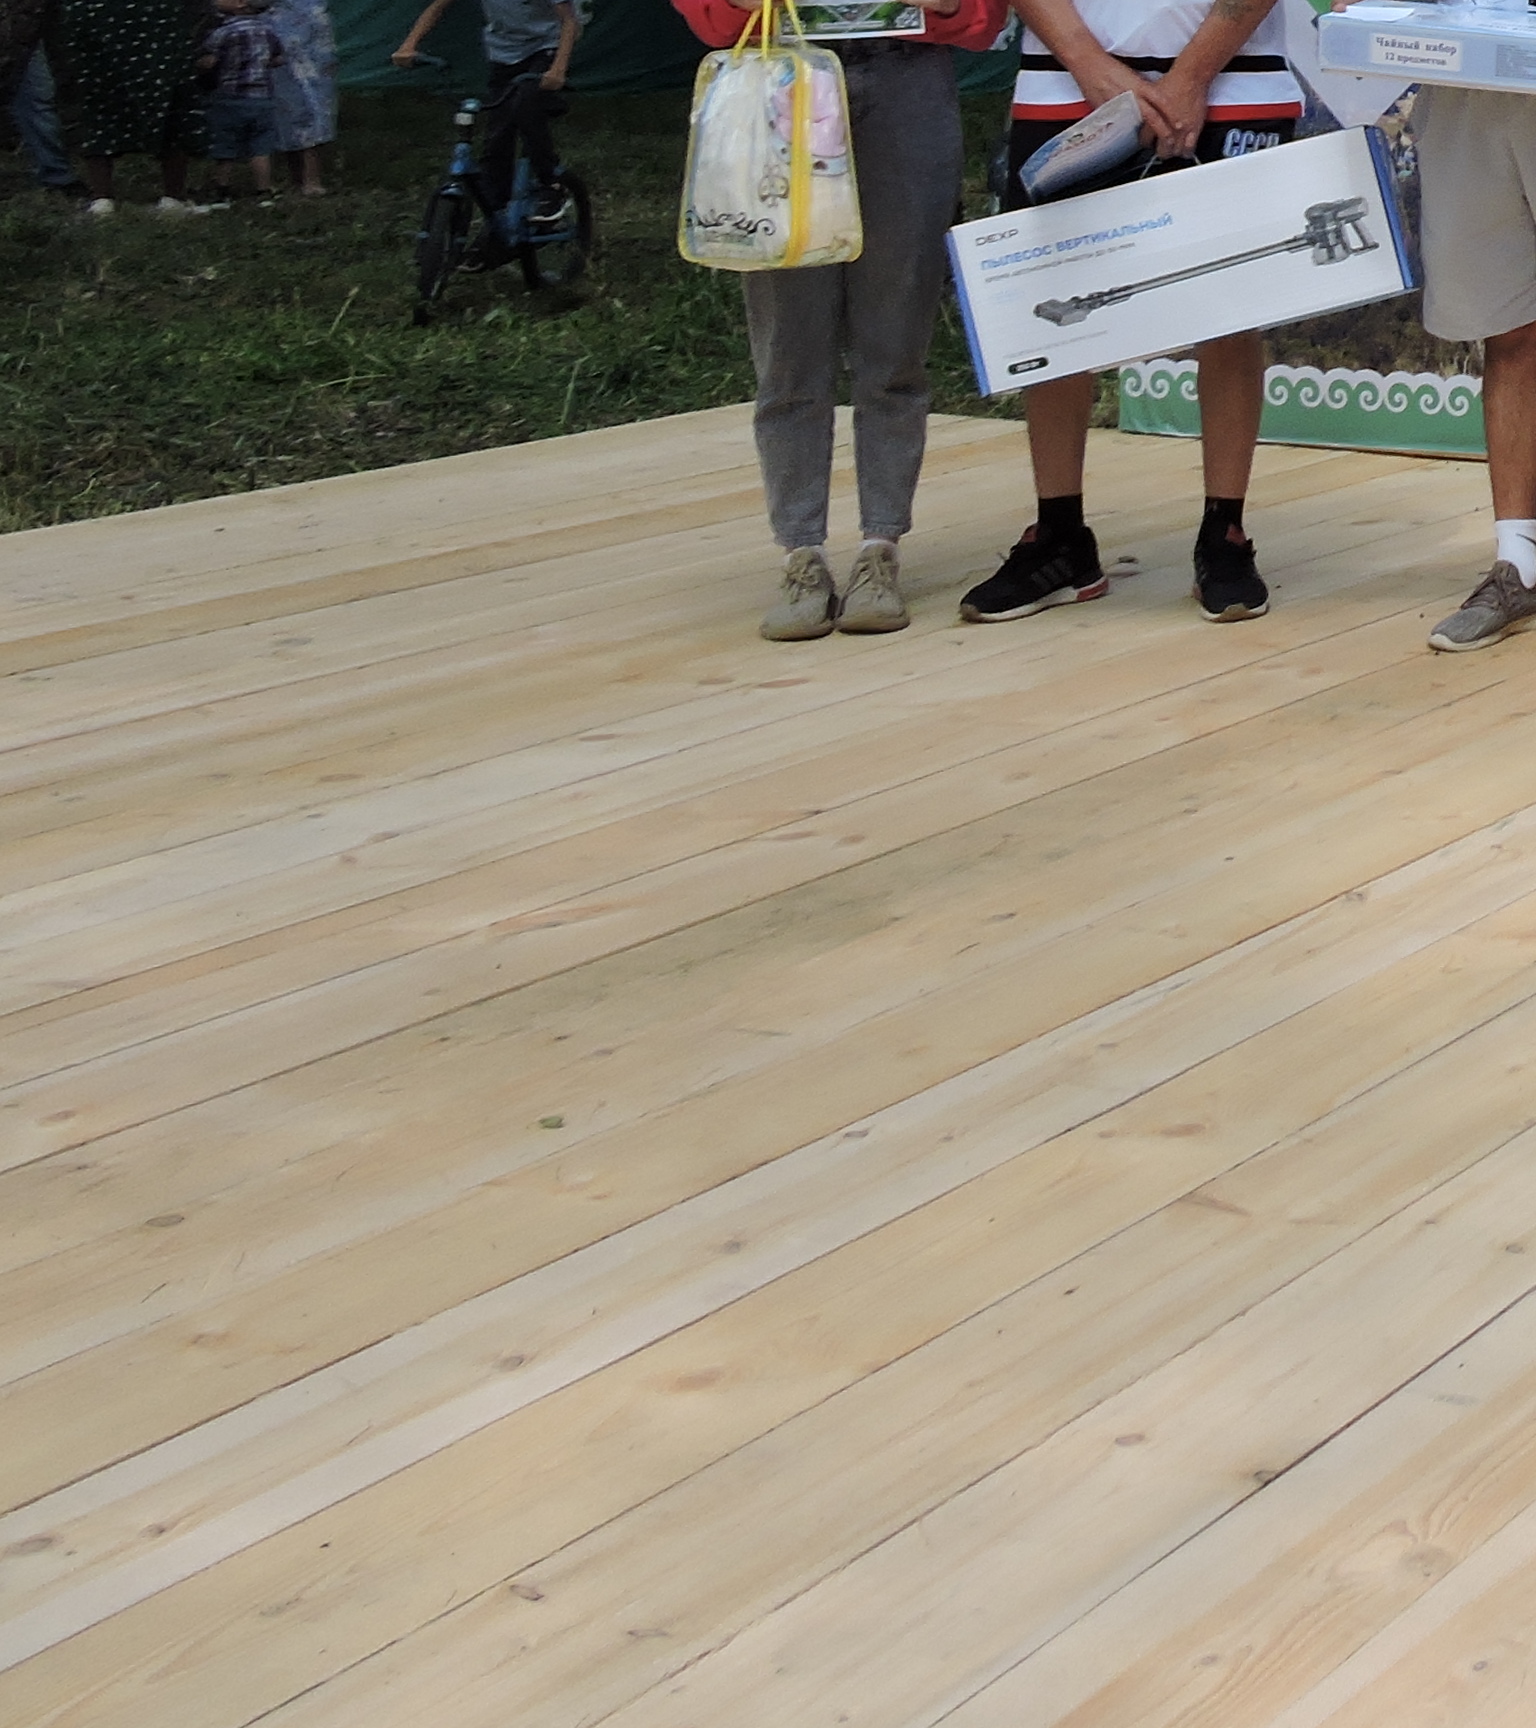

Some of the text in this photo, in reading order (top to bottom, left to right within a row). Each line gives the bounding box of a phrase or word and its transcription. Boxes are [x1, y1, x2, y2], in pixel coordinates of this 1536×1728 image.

[1376, 37, 1457, 56] Чайный набор
[1385, 52, 1395, 61] 12
[975, 228, 1019, 247] DEXP
[981, 244, 1053, 271] ПЫЛЕСОС
[1056, 212, 1173, 252] ВЕРТИКАЛЬНЫЙ
